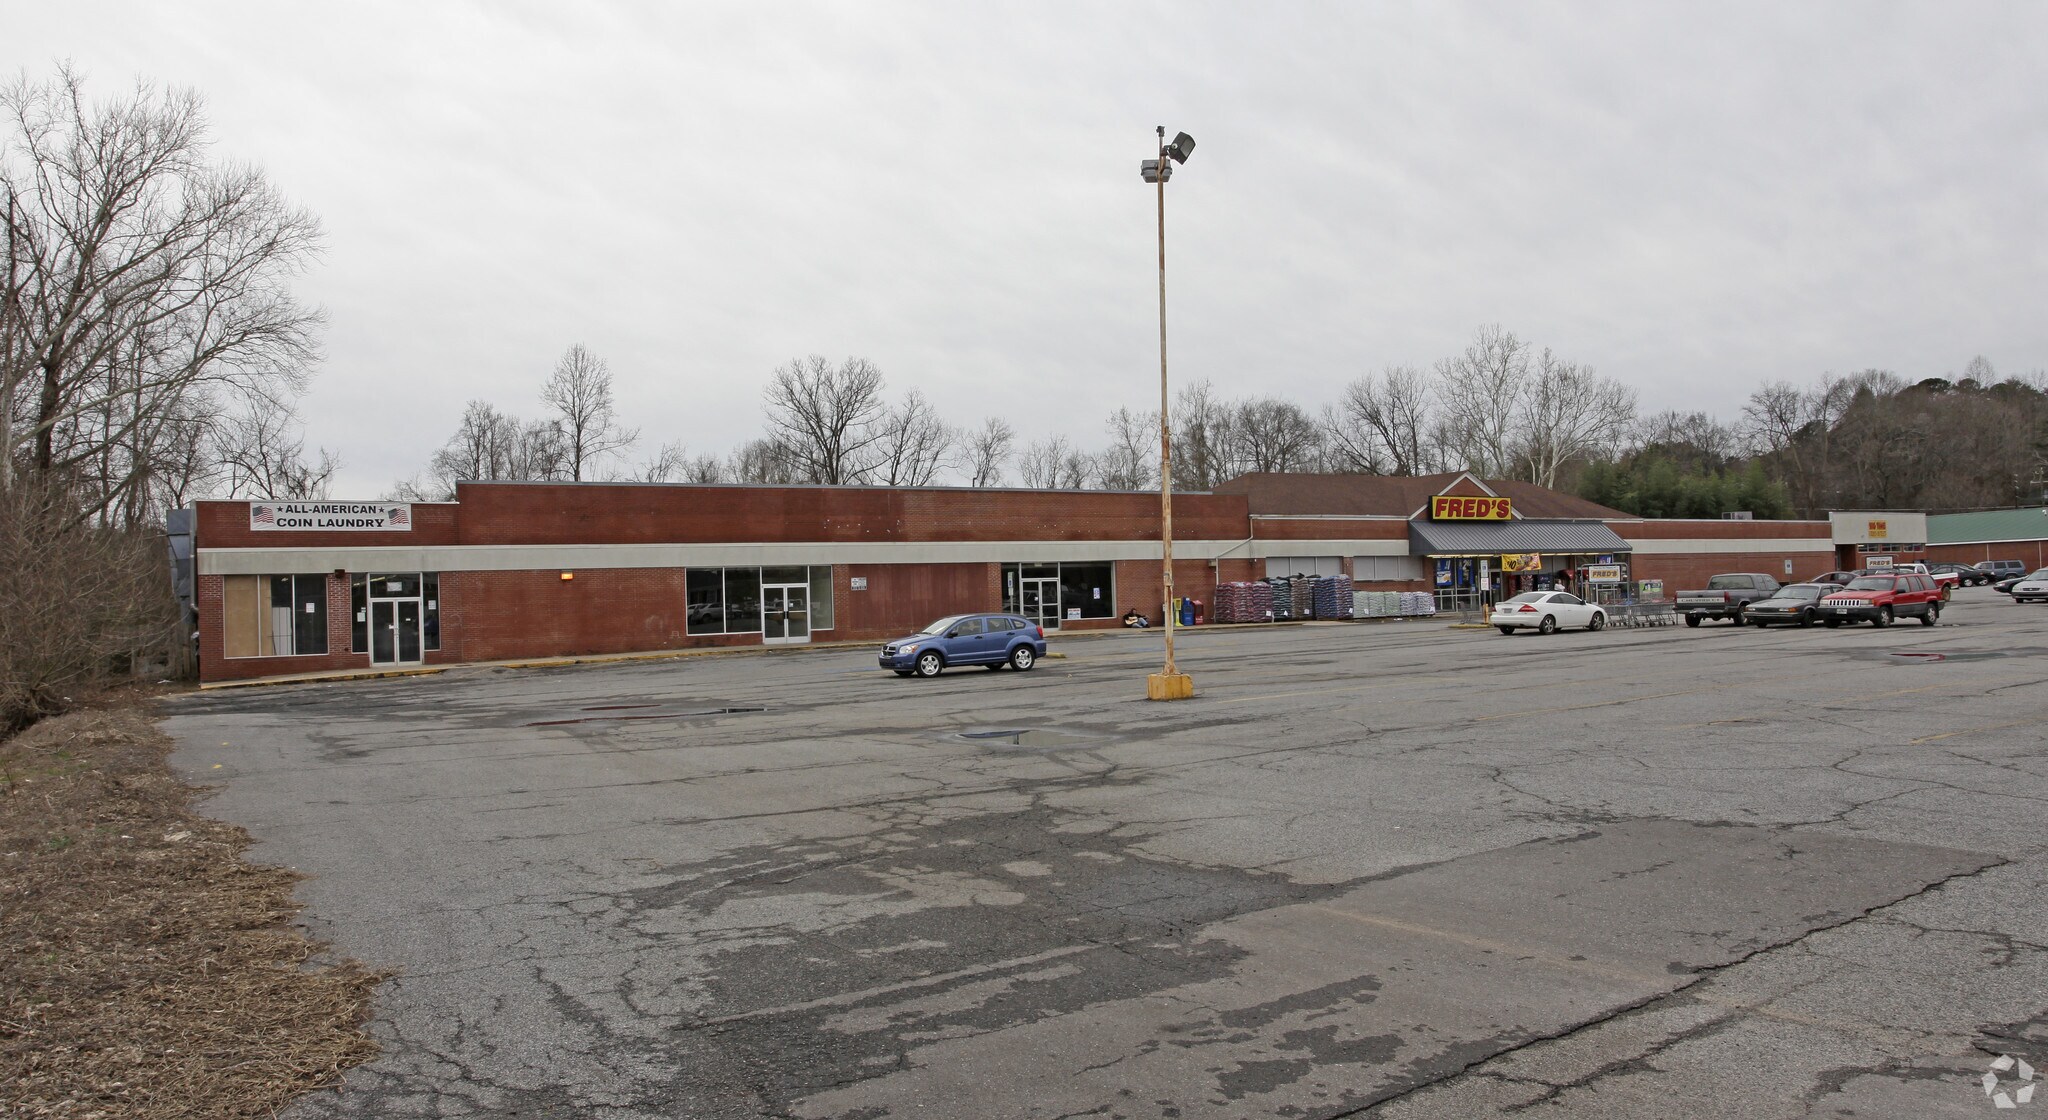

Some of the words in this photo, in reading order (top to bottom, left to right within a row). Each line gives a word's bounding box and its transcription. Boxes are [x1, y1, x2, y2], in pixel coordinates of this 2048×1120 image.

[285, 504, 376, 514] ALL-AMERICAN
[1435, 498, 1509, 518] FRED'S
[276, 517, 312, 528] COIN
[317, 517, 384, 528] LAUNDRY
[1592, 570, 1617, 578] FRED'S
